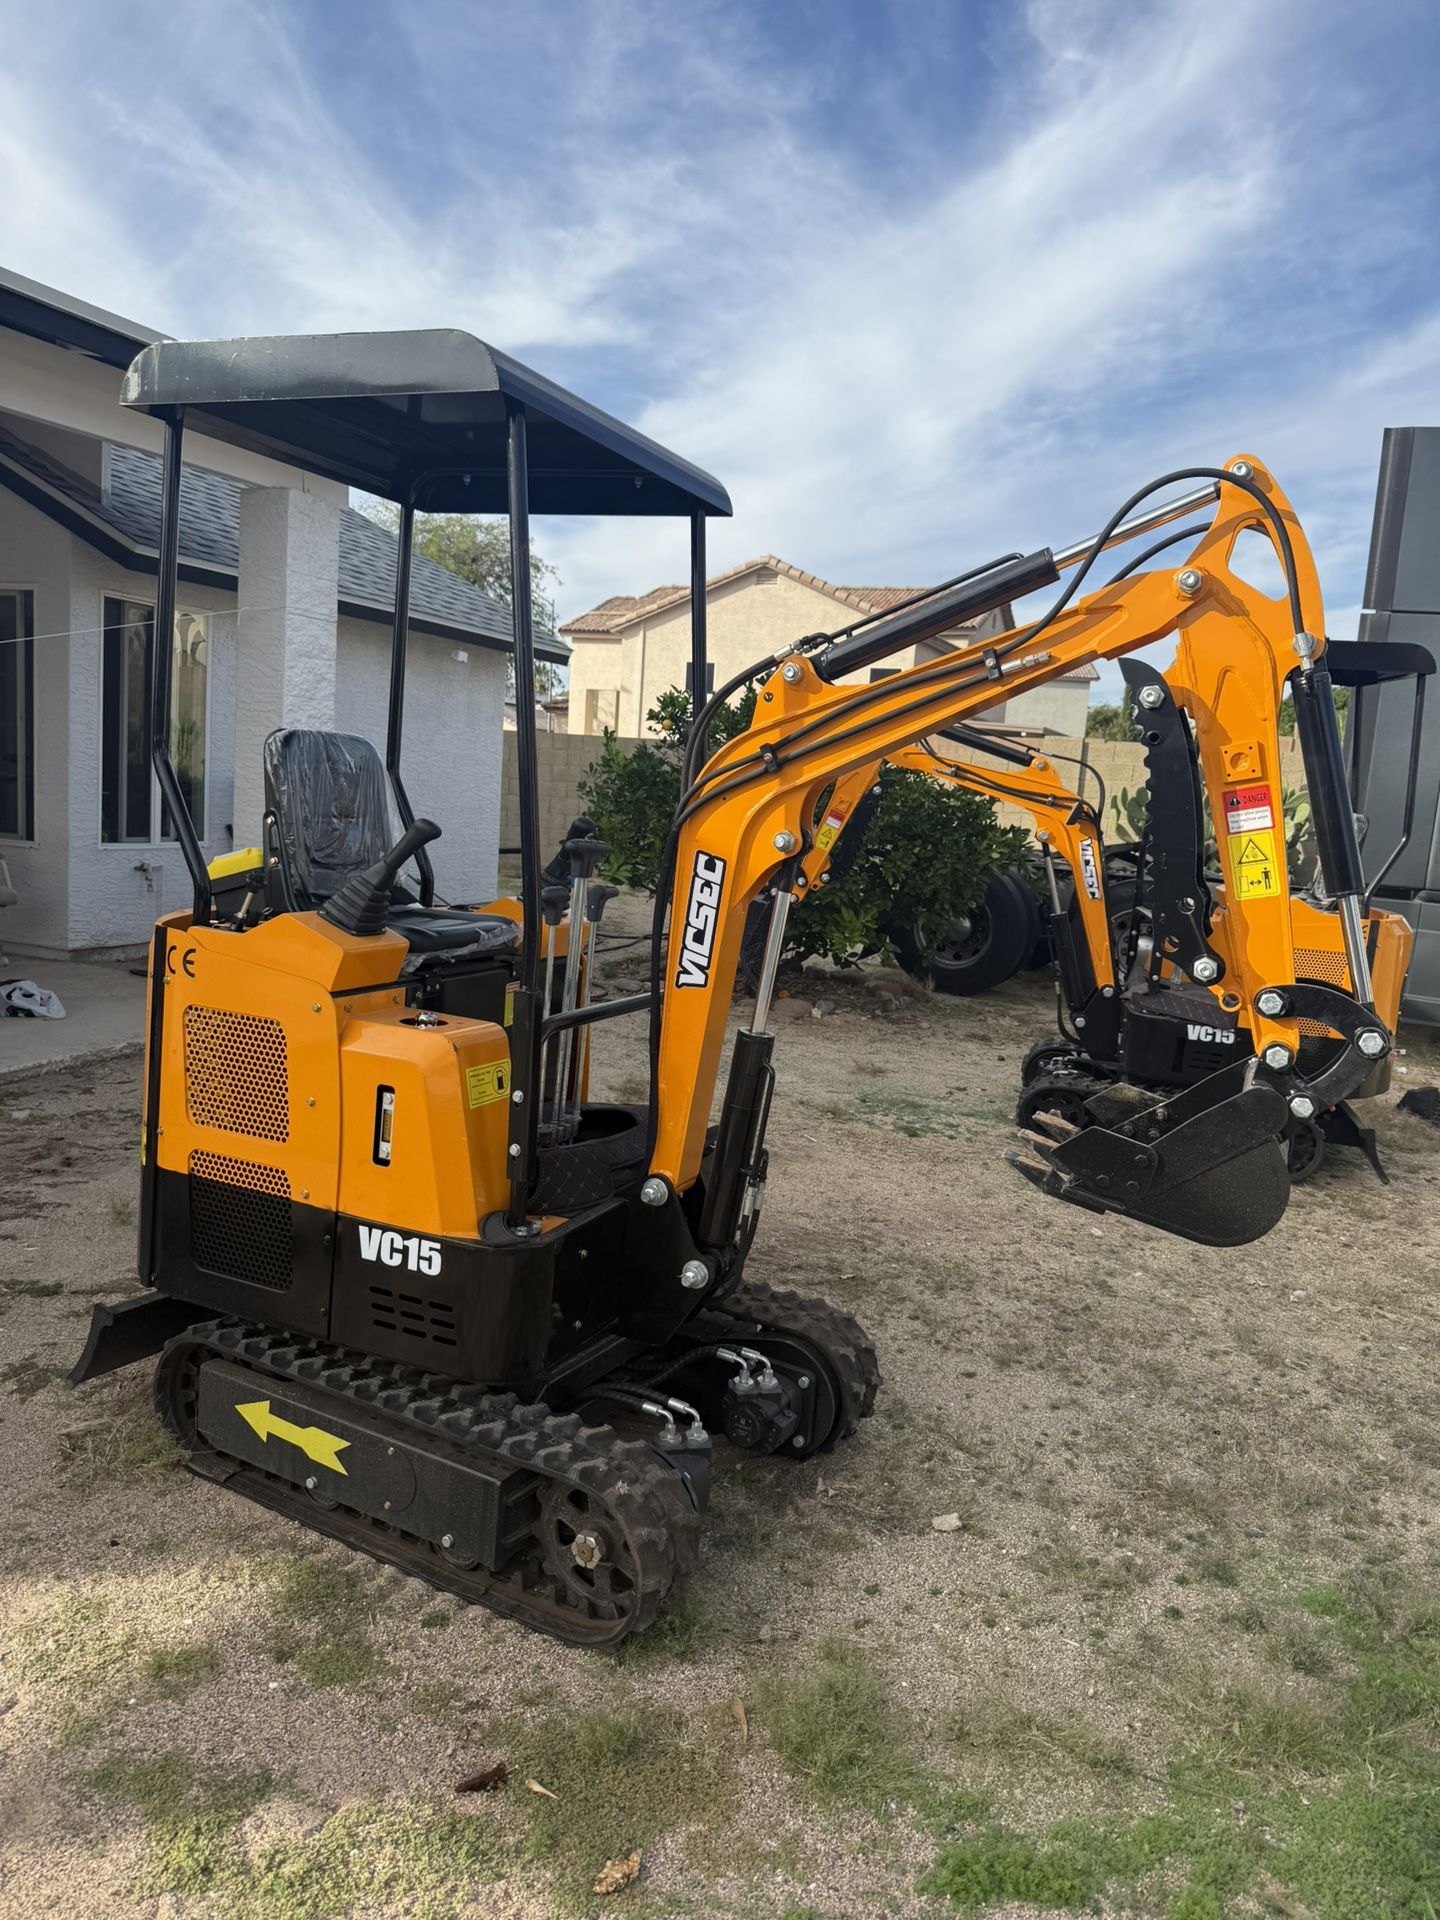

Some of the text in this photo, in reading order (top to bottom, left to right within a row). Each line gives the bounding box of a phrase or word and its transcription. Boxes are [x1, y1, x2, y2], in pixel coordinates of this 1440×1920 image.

[1243, 792, 1268, 805] DANGER
[1081, 837, 1100, 900] VICSEC
[677, 851, 726, 987] VICSEC
[1187, 1024, 1235, 1044] VC15
[358, 1224, 442, 1276] VC15
